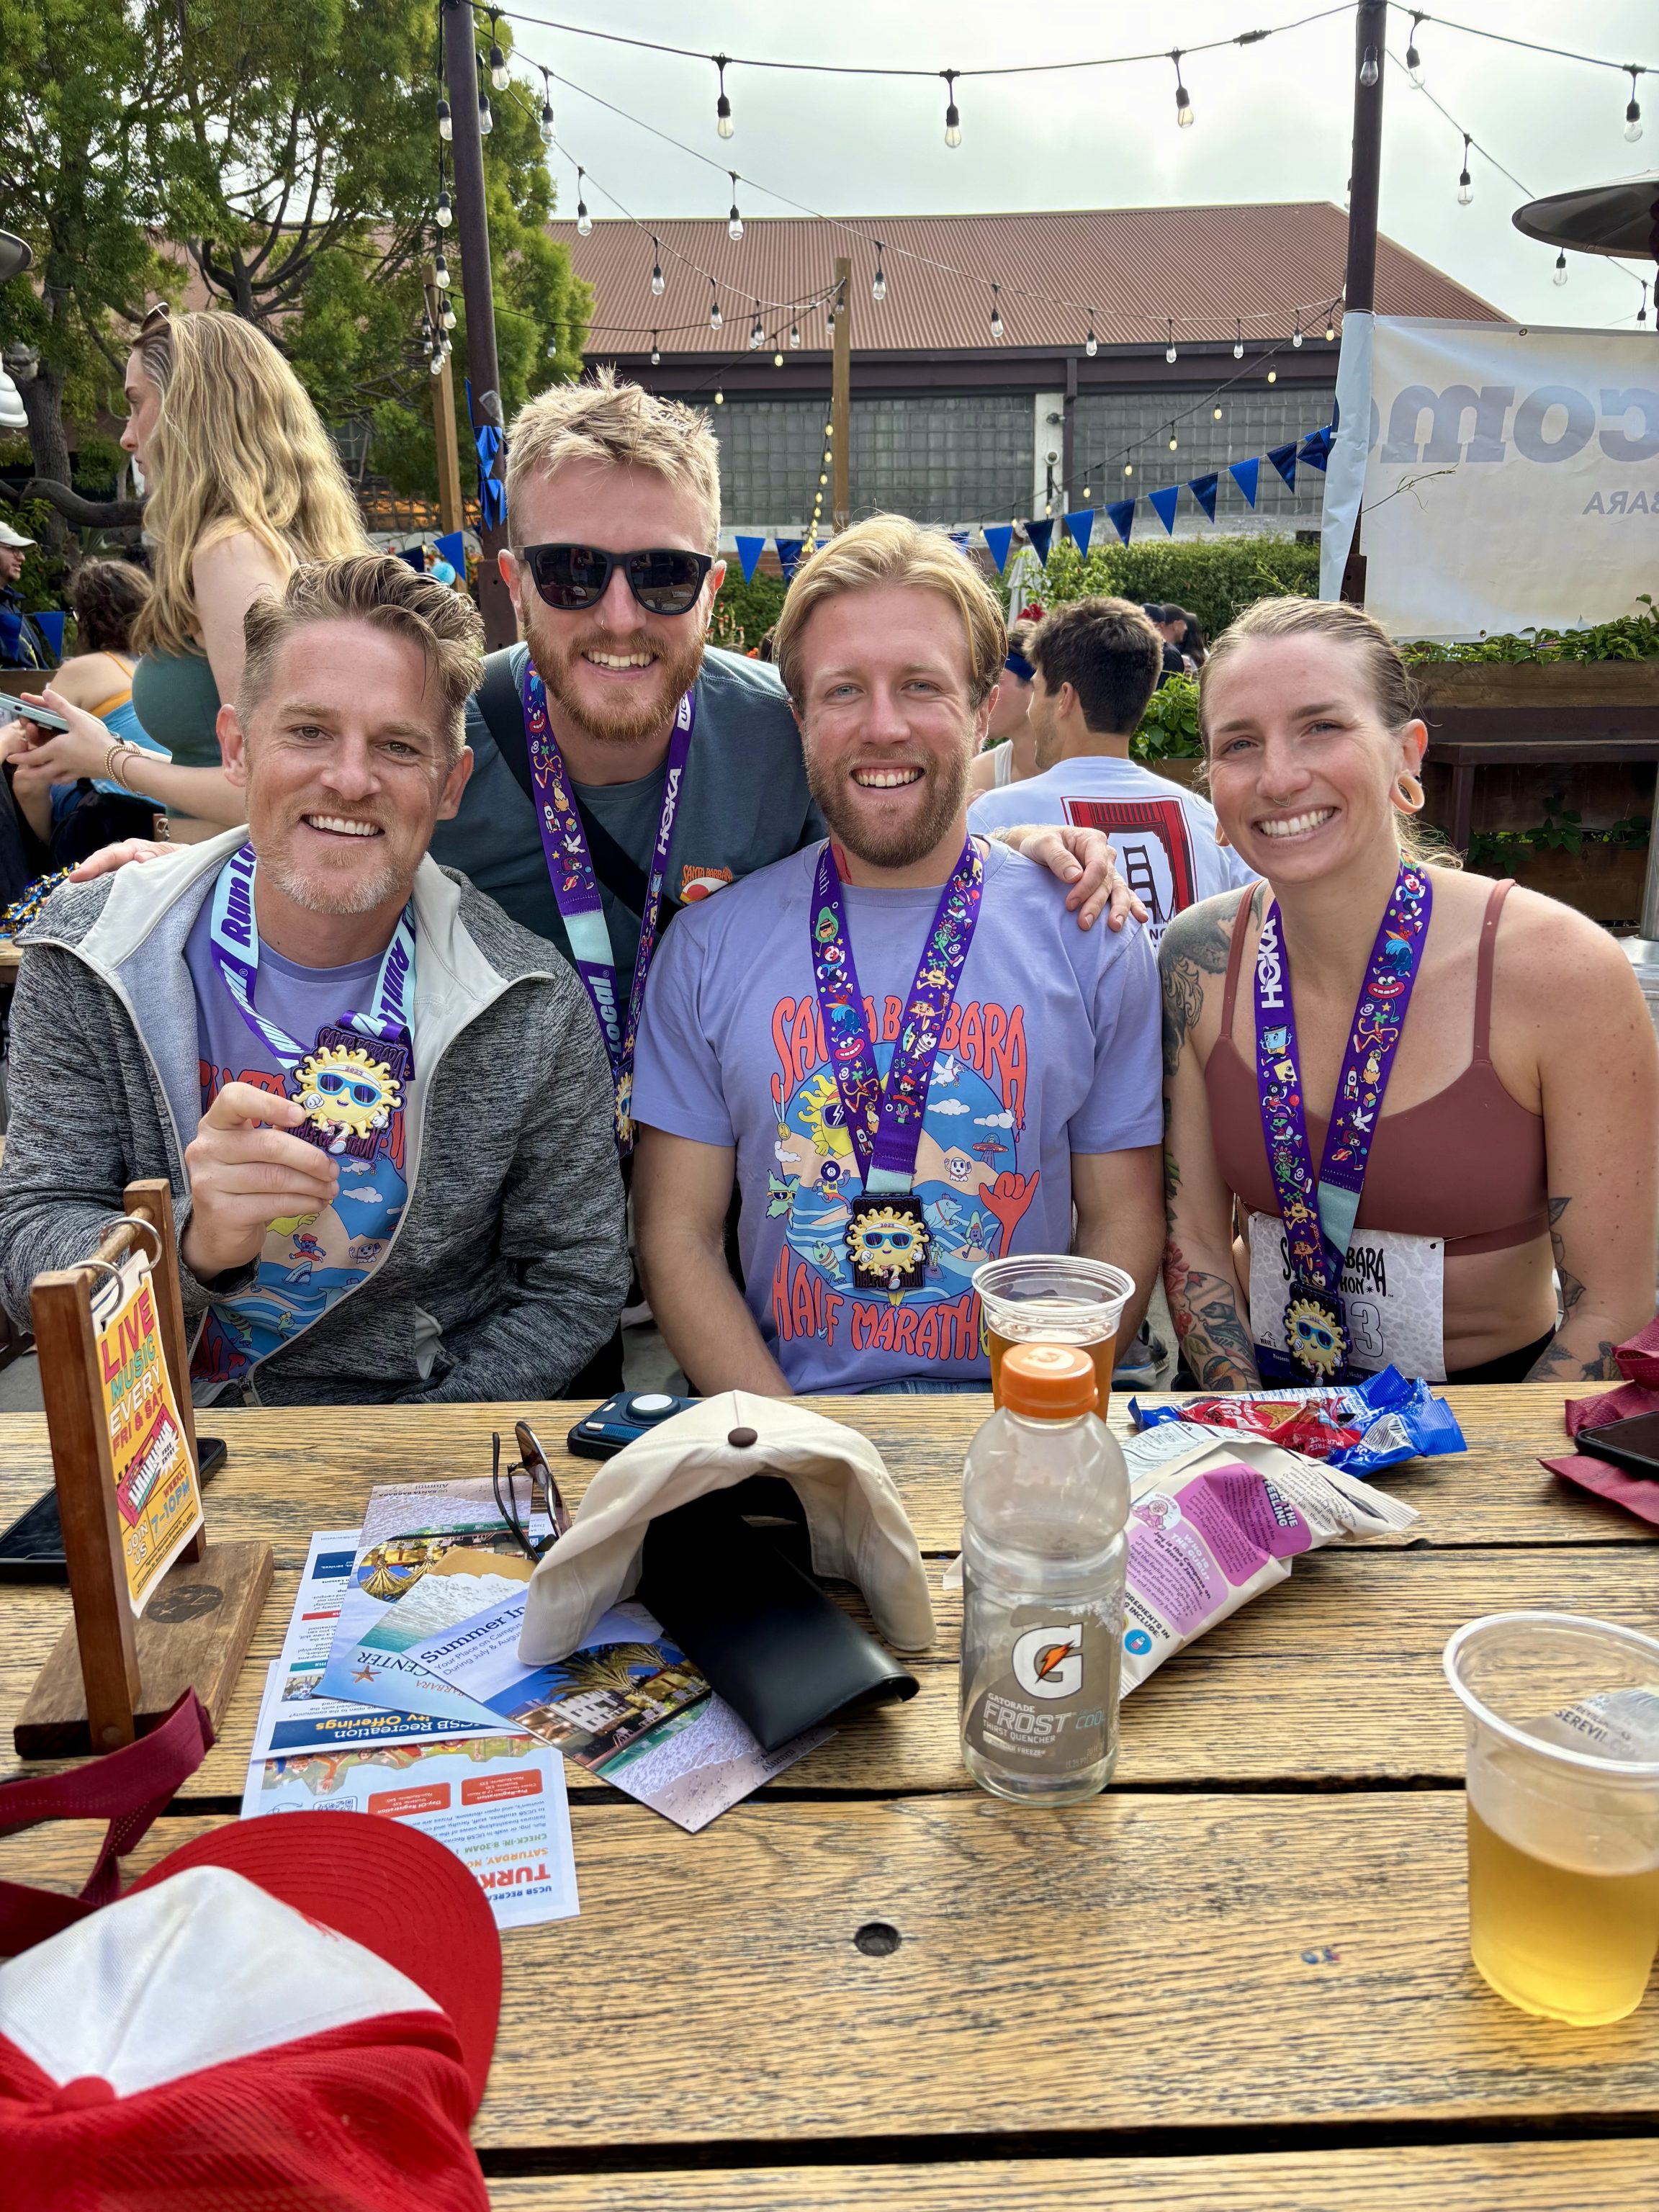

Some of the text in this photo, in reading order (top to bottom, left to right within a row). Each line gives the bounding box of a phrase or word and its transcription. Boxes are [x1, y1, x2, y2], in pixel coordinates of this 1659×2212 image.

[657, 768, 683, 855] HOKA
[681, 864, 704, 886] SANTA
[1257, 917, 1285, 1008] HOKA
[772, 1244, 844, 1347] HALF
[102, 1287, 154, 1385] LIVE
[1259, 1337, 1274, 1346] WAVE
[1350, 1300, 1385, 1361] 3
[111, 1334, 156, 1406] MUSIC
[109, 1355, 160, 1438] EVERY
[112, 1384, 164, 1457] FRI & SAT
[161, 1442, 172, 1456] FREE
[161, 1447, 176, 1465] ENTRY
[163, 1463, 187, 1498] WEEKLY
[150, 1476, 190, 1534] 7-10PM
[1262, 1478, 1287, 1527] FEELING
[1282, 1501, 1300, 1528] THE
[1309, 1512, 1318, 1521] the
[1321, 1513, 1331, 1523] with
[127, 1519, 149, 1557] JOIN
[133, 1542, 148, 1565] US
[1183, 1533, 1203, 1556] WHO
[1154, 1529, 1165, 1542] Joy
[1172, 1546, 1183, 1557] the
[1181, 1557, 1208, 1587] Compass
[1203, 1589, 1212, 1599] on
[1154, 1538, 1207, 1596] the Hero's Journey.
[1169, 1532, 1213, 1581] THE GURU?
[1172, 1566, 1182, 1575] the
[1130, 1606, 1159, 1639] INCLUDE:
[1161, 1629, 1170, 1639] IN
[418, 1610, 508, 1668] Summer
[433, 1655, 456, 1672] Your
[454, 1642, 478, 1660] Place
[477, 1638, 489, 1647] on
[441, 1655, 474, 1678] During
[471, 1646, 490, 1662] July
[1012, 1623, 1084, 1700] G
[983, 1699, 1074, 1735] FROST
[987, 1692, 1036, 1713] GATORADE
[314, 1712, 401, 1733] Offerings
[333, 1721, 433, 1740] Recreation
[981, 1719, 1009, 1736] THIRST
[1009, 1729, 1056, 1747] QUENCHER
[762, 1748, 796, 1773] Alumni
[464, 1840, 500, 1853] 8:30AM
[501, 1832, 547, 1847] CHECK-IN:
[485, 1847, 549, 1865] SATURDAY,
[525, 1884, 552, 1895] UCSB
